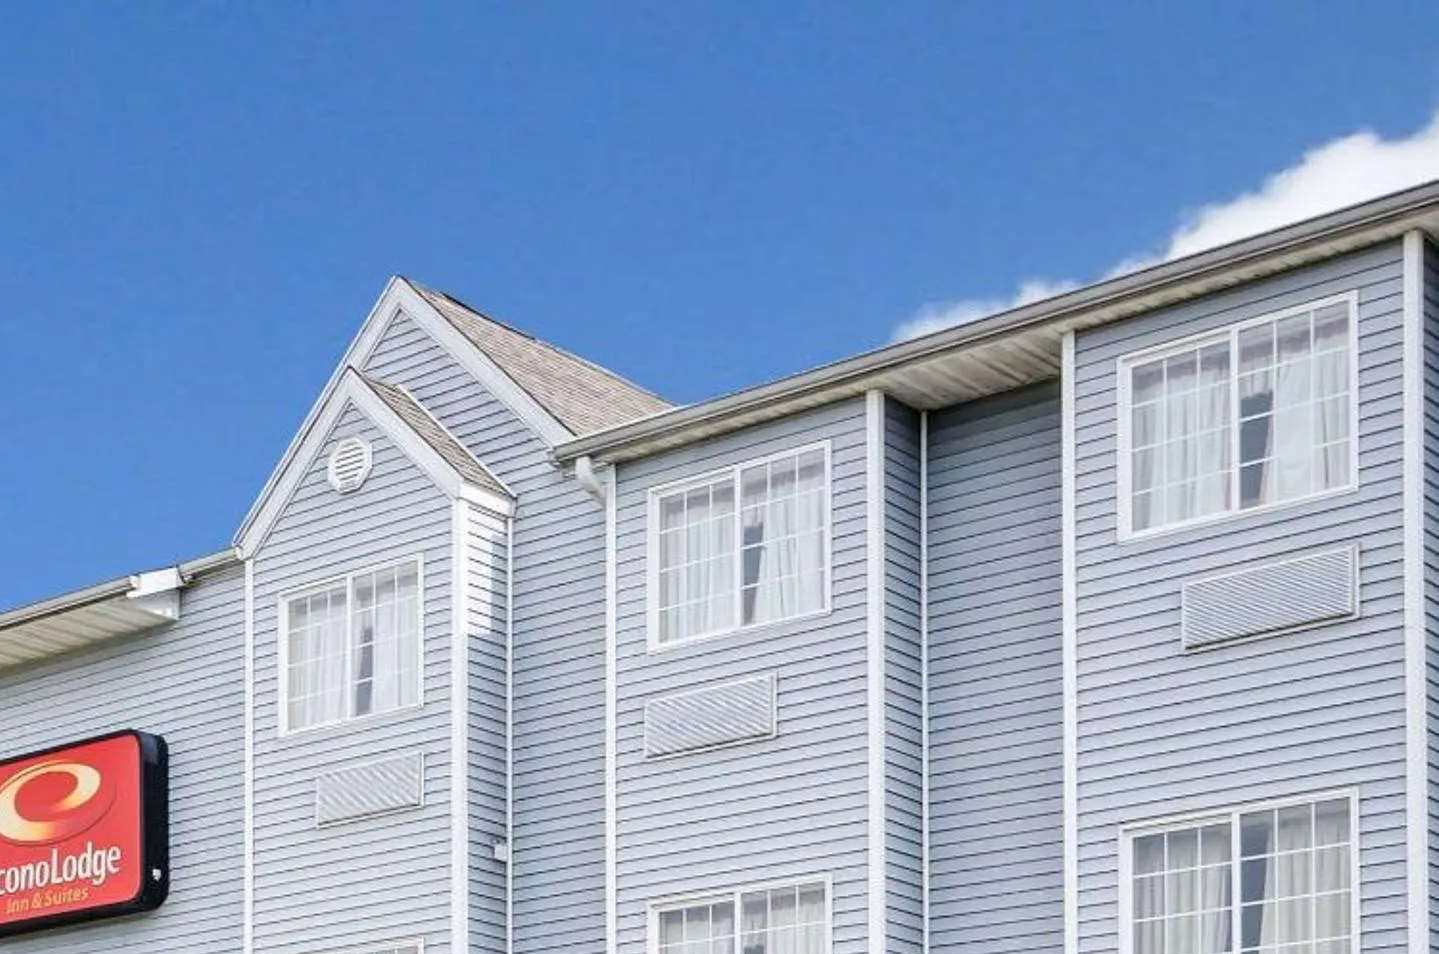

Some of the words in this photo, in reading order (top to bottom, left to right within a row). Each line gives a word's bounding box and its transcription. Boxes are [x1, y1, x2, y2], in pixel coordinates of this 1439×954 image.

[6, 898, 29, 914] Inn
[31, 893, 43, 909] &
[44, 886, 88, 906] Suites
